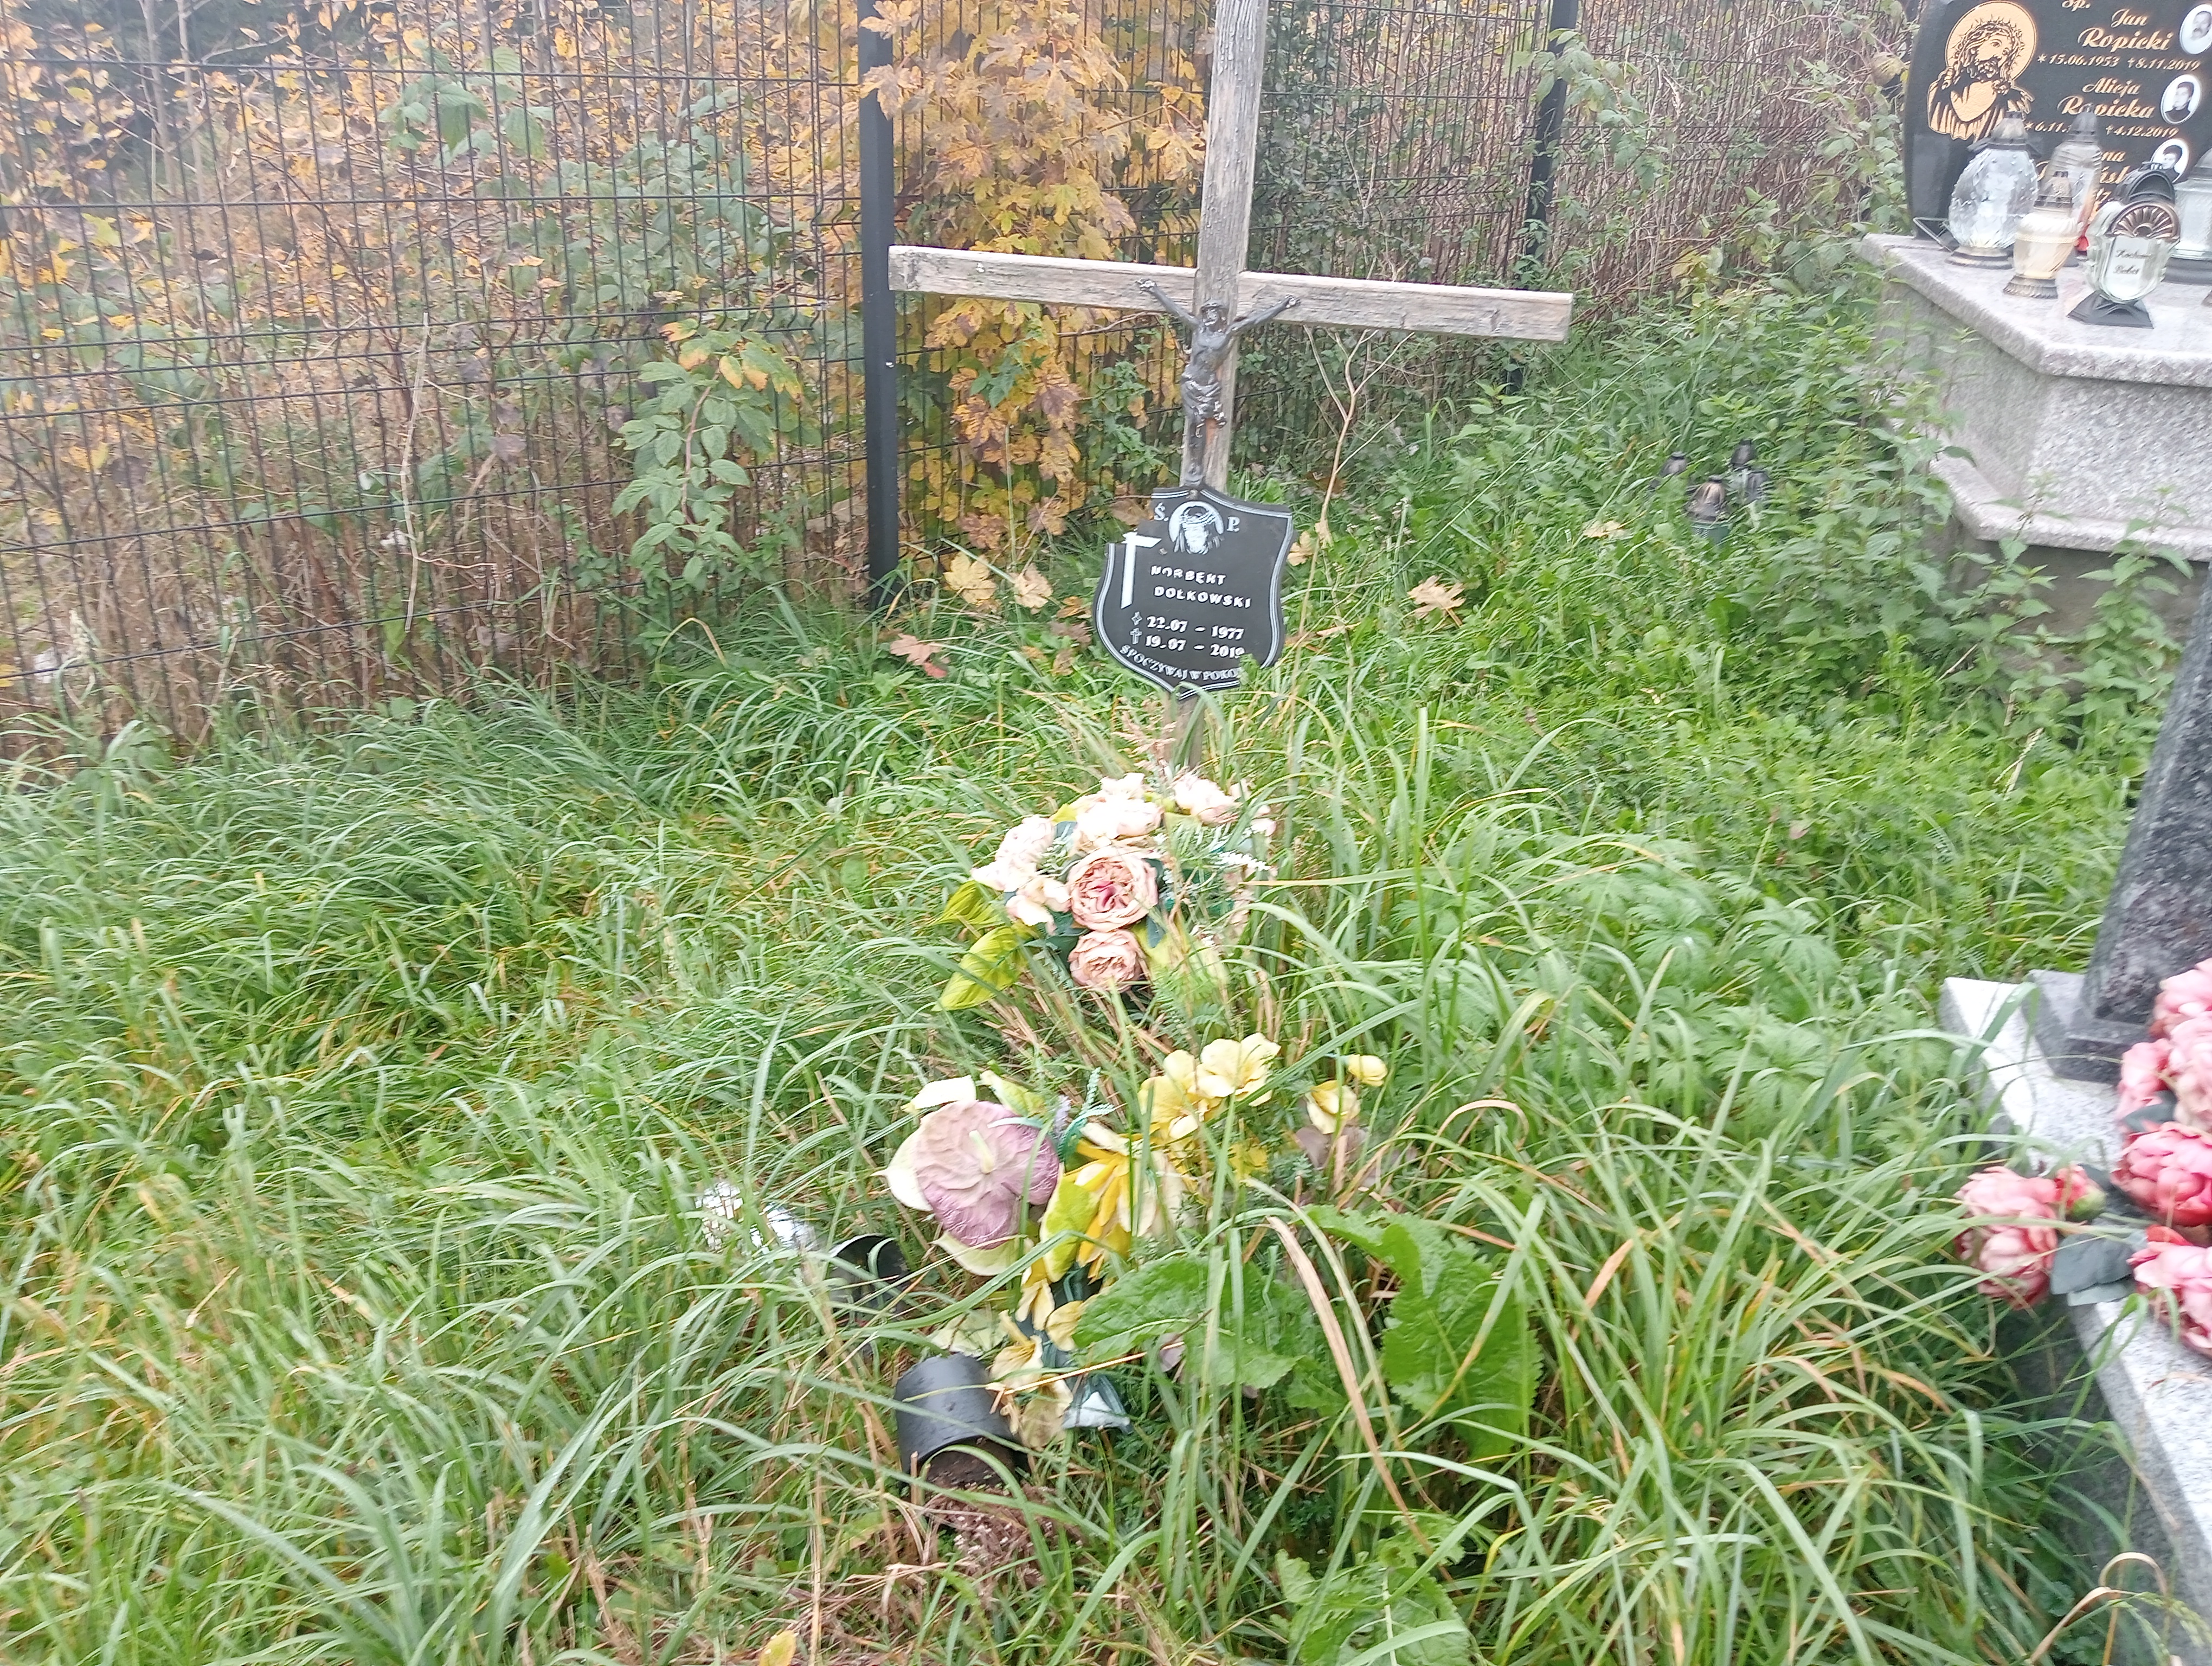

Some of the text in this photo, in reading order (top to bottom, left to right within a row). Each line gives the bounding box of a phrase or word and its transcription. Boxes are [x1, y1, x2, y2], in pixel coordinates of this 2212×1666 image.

[2111, 9, 2149, 28] Jan
[2077, 27, 2174, 53] Ropicki
[2082, 78, 2141, 98] Alicja
[1154, 585, 1252, 608] DOŁKOWSKI
[1147, 615, 1188, 633] 22.07
[1211, 625, 1245, 640] 1977
[1145, 635, 1187, 651] 19.07
[1210, 643, 1245, 659] 2019
[1120, 644, 1242, 681] SPOCZYWAJ W POKO
